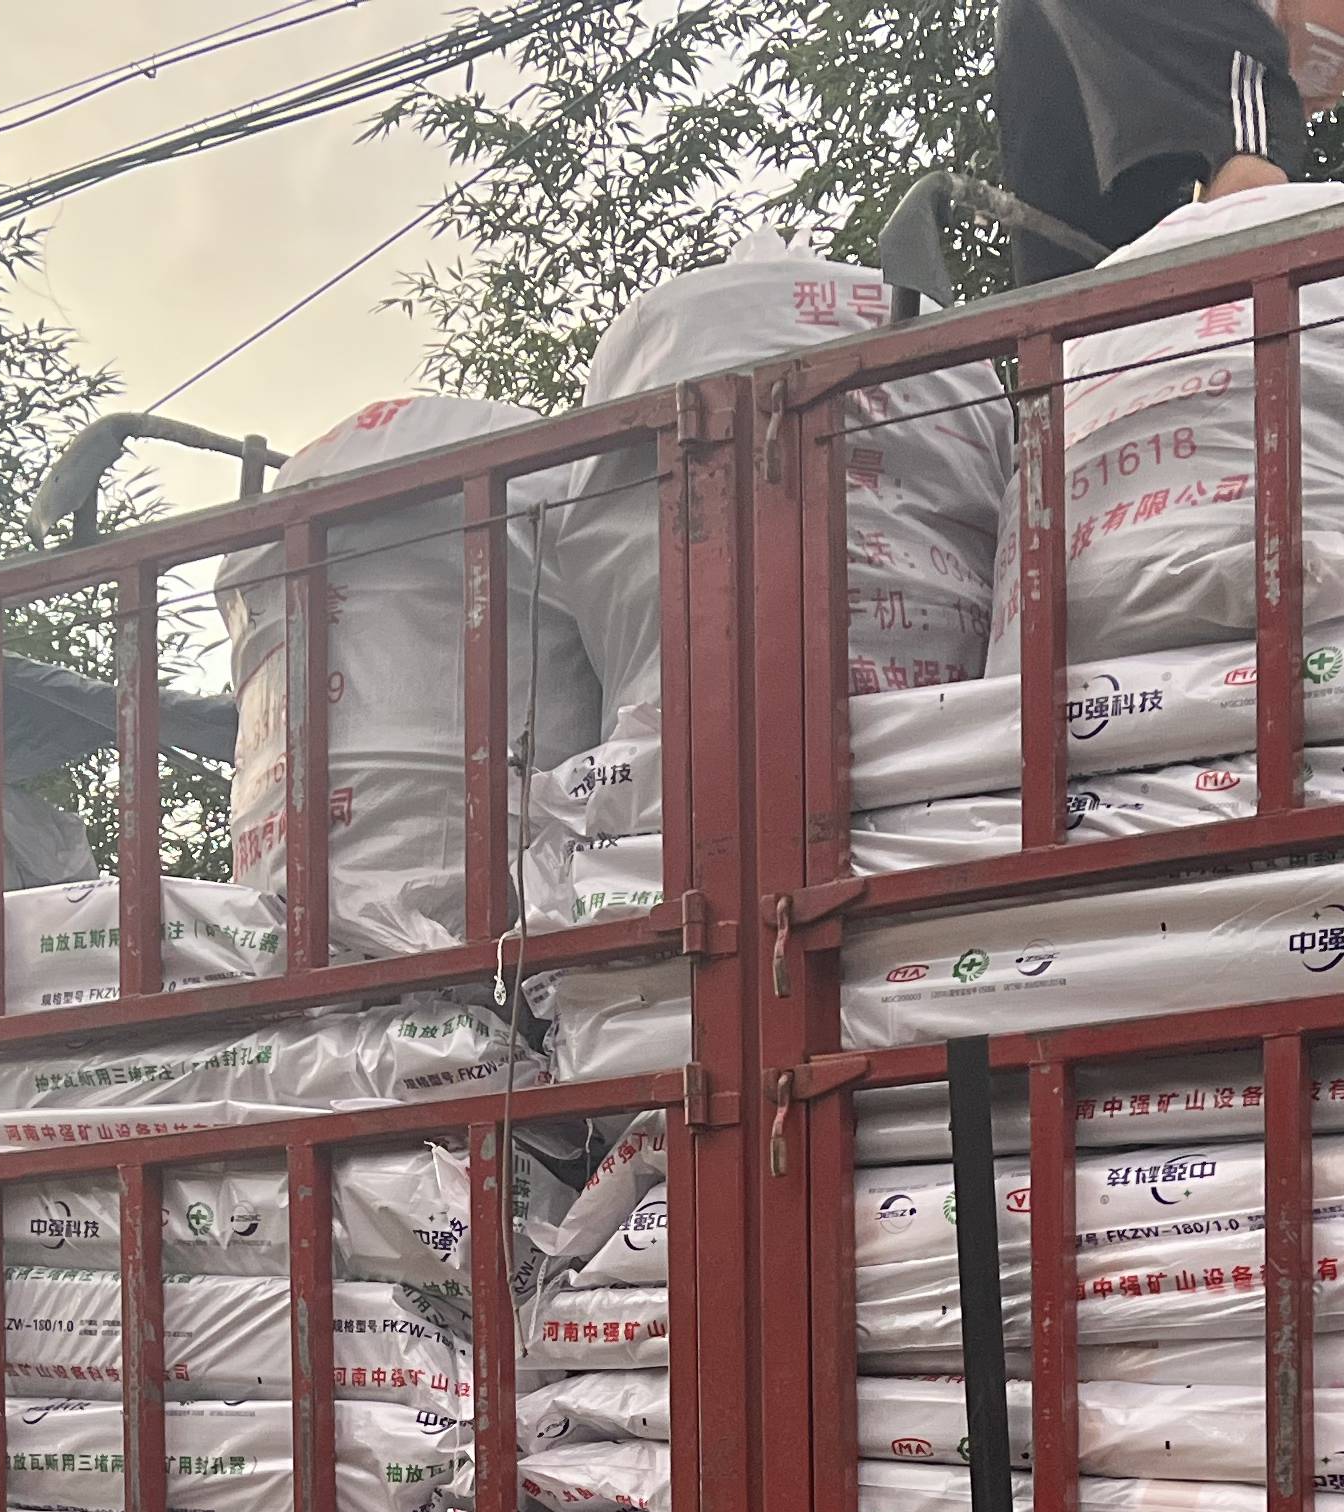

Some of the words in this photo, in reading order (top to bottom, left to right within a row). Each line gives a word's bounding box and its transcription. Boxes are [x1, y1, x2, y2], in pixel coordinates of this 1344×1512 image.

[30, 1219, 99, 1238] 中强科技
[898, 1442, 926, 1454] MA
